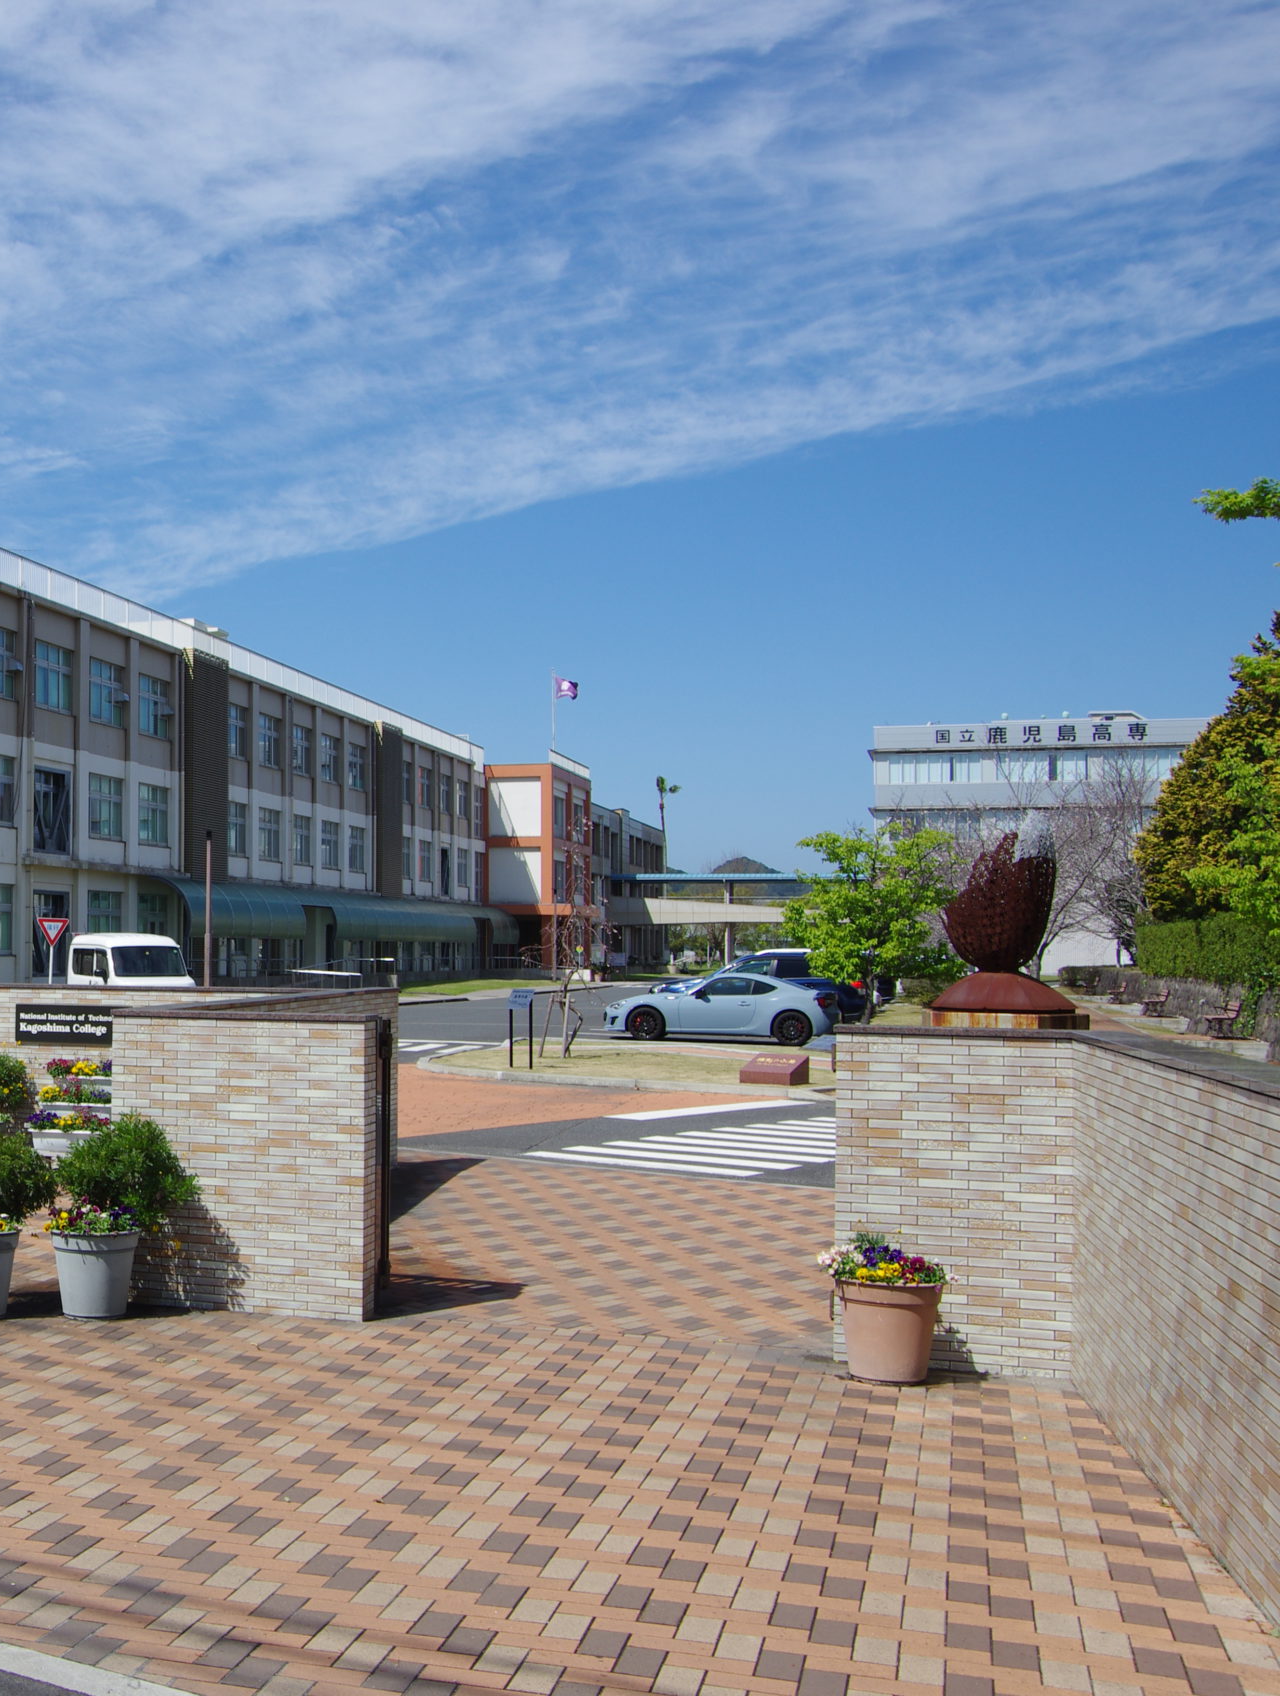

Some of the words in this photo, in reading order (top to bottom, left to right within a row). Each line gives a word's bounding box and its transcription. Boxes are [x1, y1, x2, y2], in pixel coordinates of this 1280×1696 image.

[935, 729, 974, 744] 国立
[988, 723, 1148, 744] 鹿児島高専
[20, 1012, 47, 1020] National
[48, 1013, 76, 1021] Institute
[88, 1014, 114, 1022] Techno
[20, 1022, 70, 1034] Kagoshima
[73, 1023, 107, 1036] College
